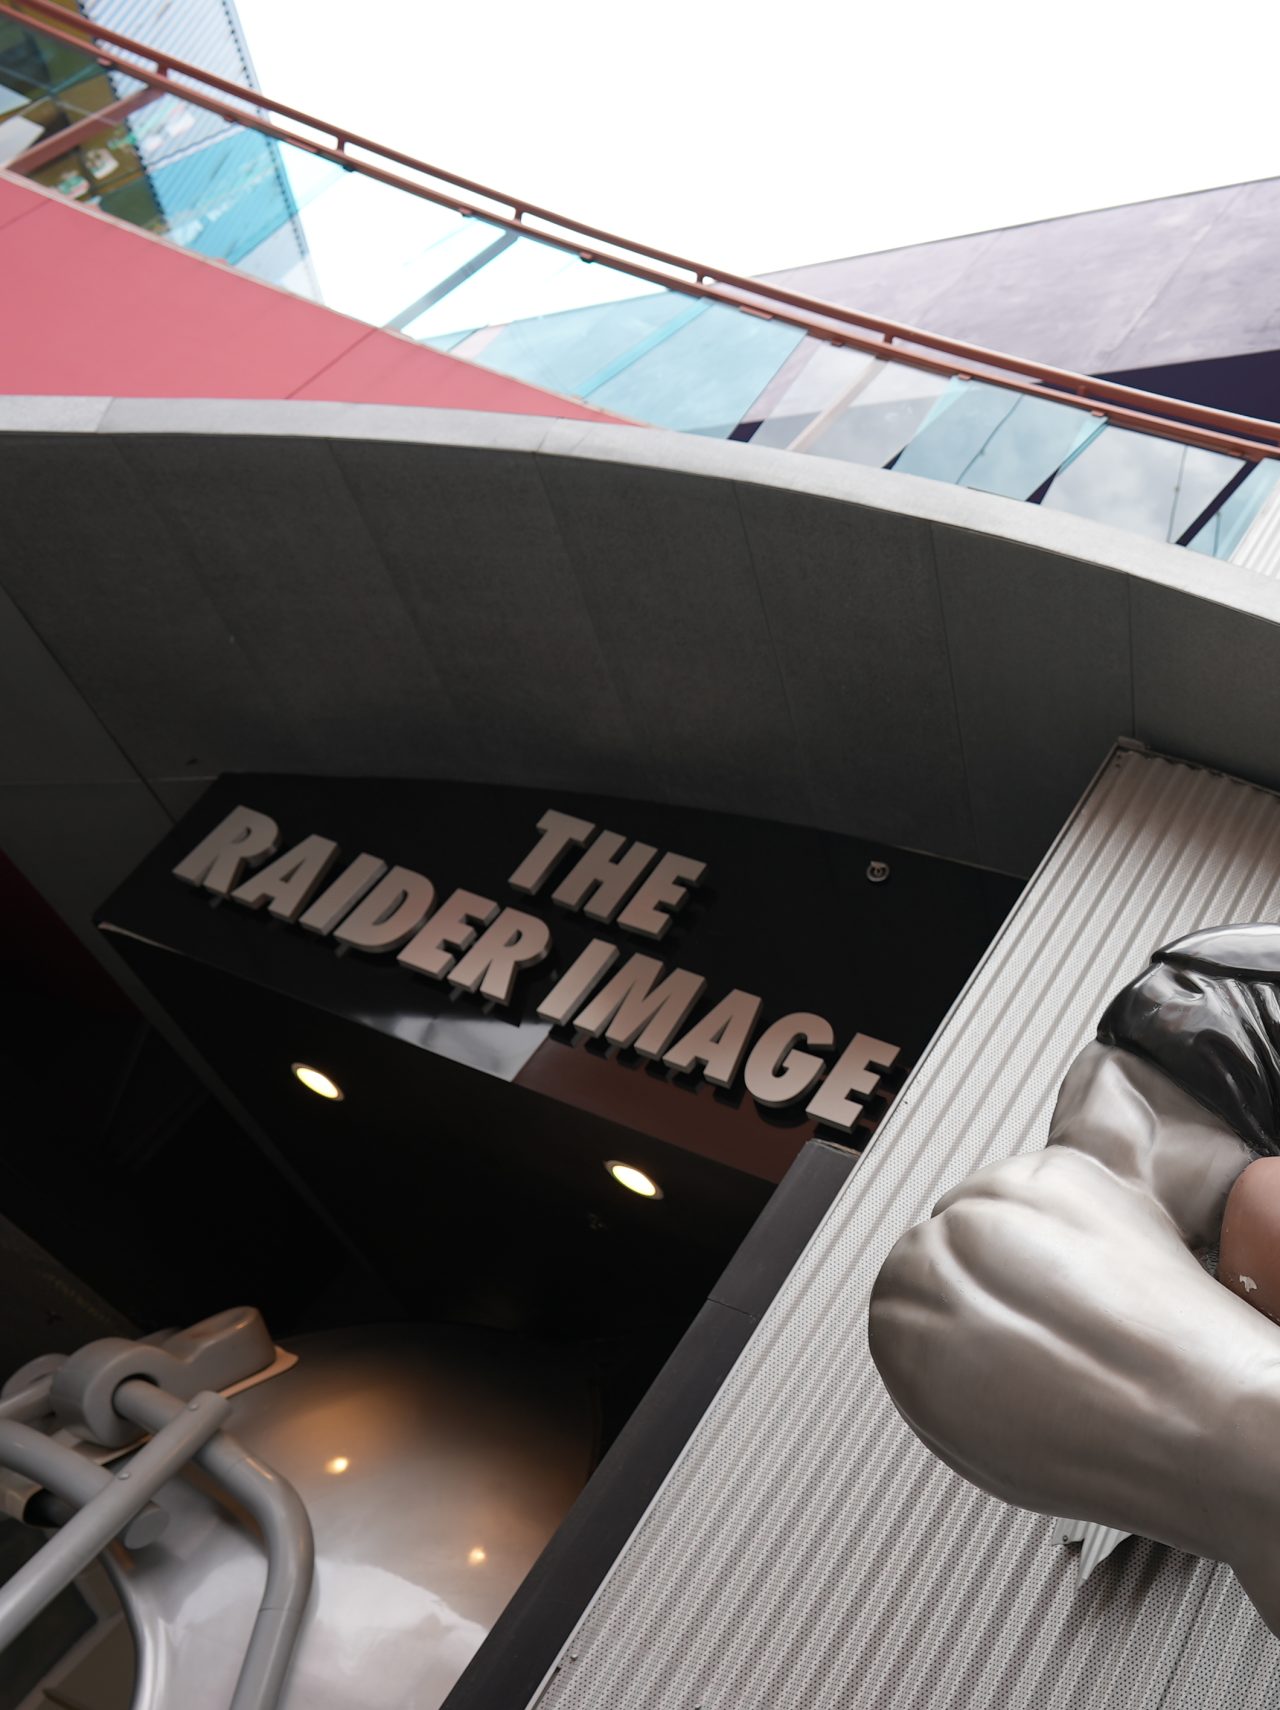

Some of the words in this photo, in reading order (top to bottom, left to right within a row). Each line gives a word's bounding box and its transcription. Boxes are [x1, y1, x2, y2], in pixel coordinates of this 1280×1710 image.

[172, 804, 552, 1002] RAIDER
[537, 937, 902, 1133] IMAGE
[508, 808, 707, 941] THE
